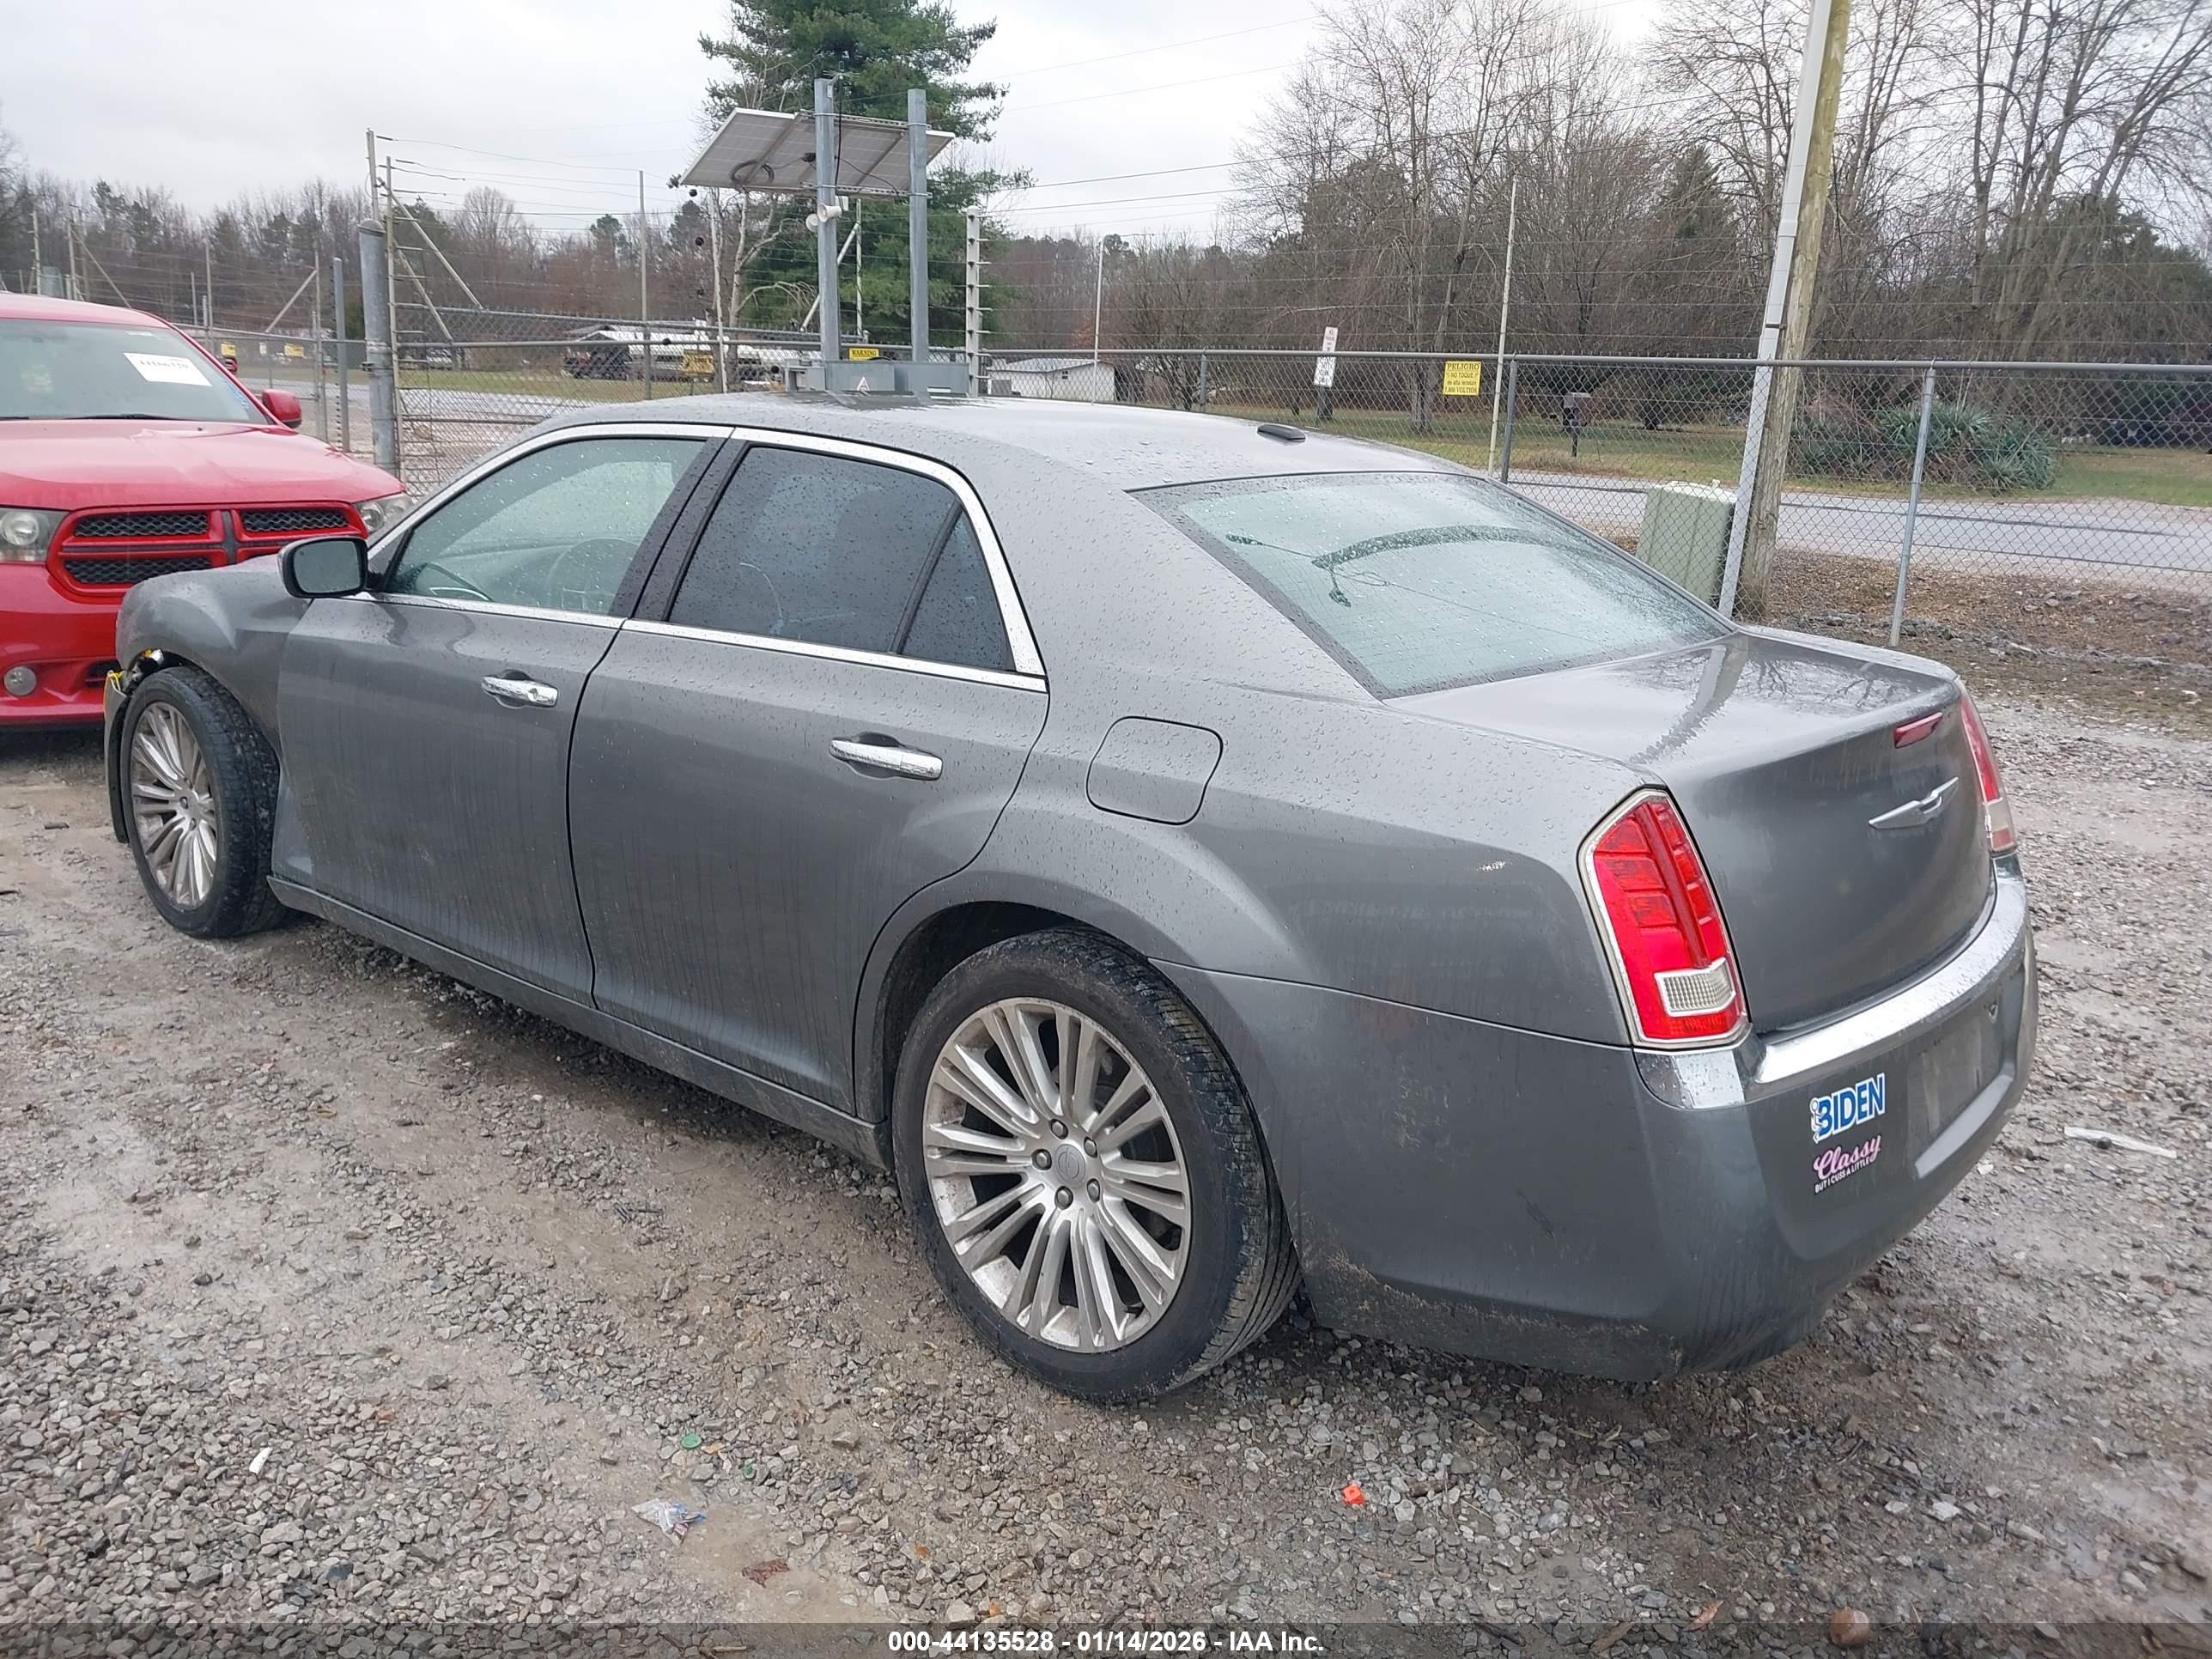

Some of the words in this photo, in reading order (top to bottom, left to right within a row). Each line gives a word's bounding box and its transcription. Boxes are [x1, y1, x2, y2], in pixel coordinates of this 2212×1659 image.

[1816, 1073, 1885, 1140] BIDEN
[1814, 1135, 1881, 1180] Classy
[1814, 1180, 1827, 1193] BUT
[1830, 1170, 1845, 1183] CUSS
[1846, 1167, 1851, 1176] A
[1851, 1156, 1869, 1173] LITTLE
